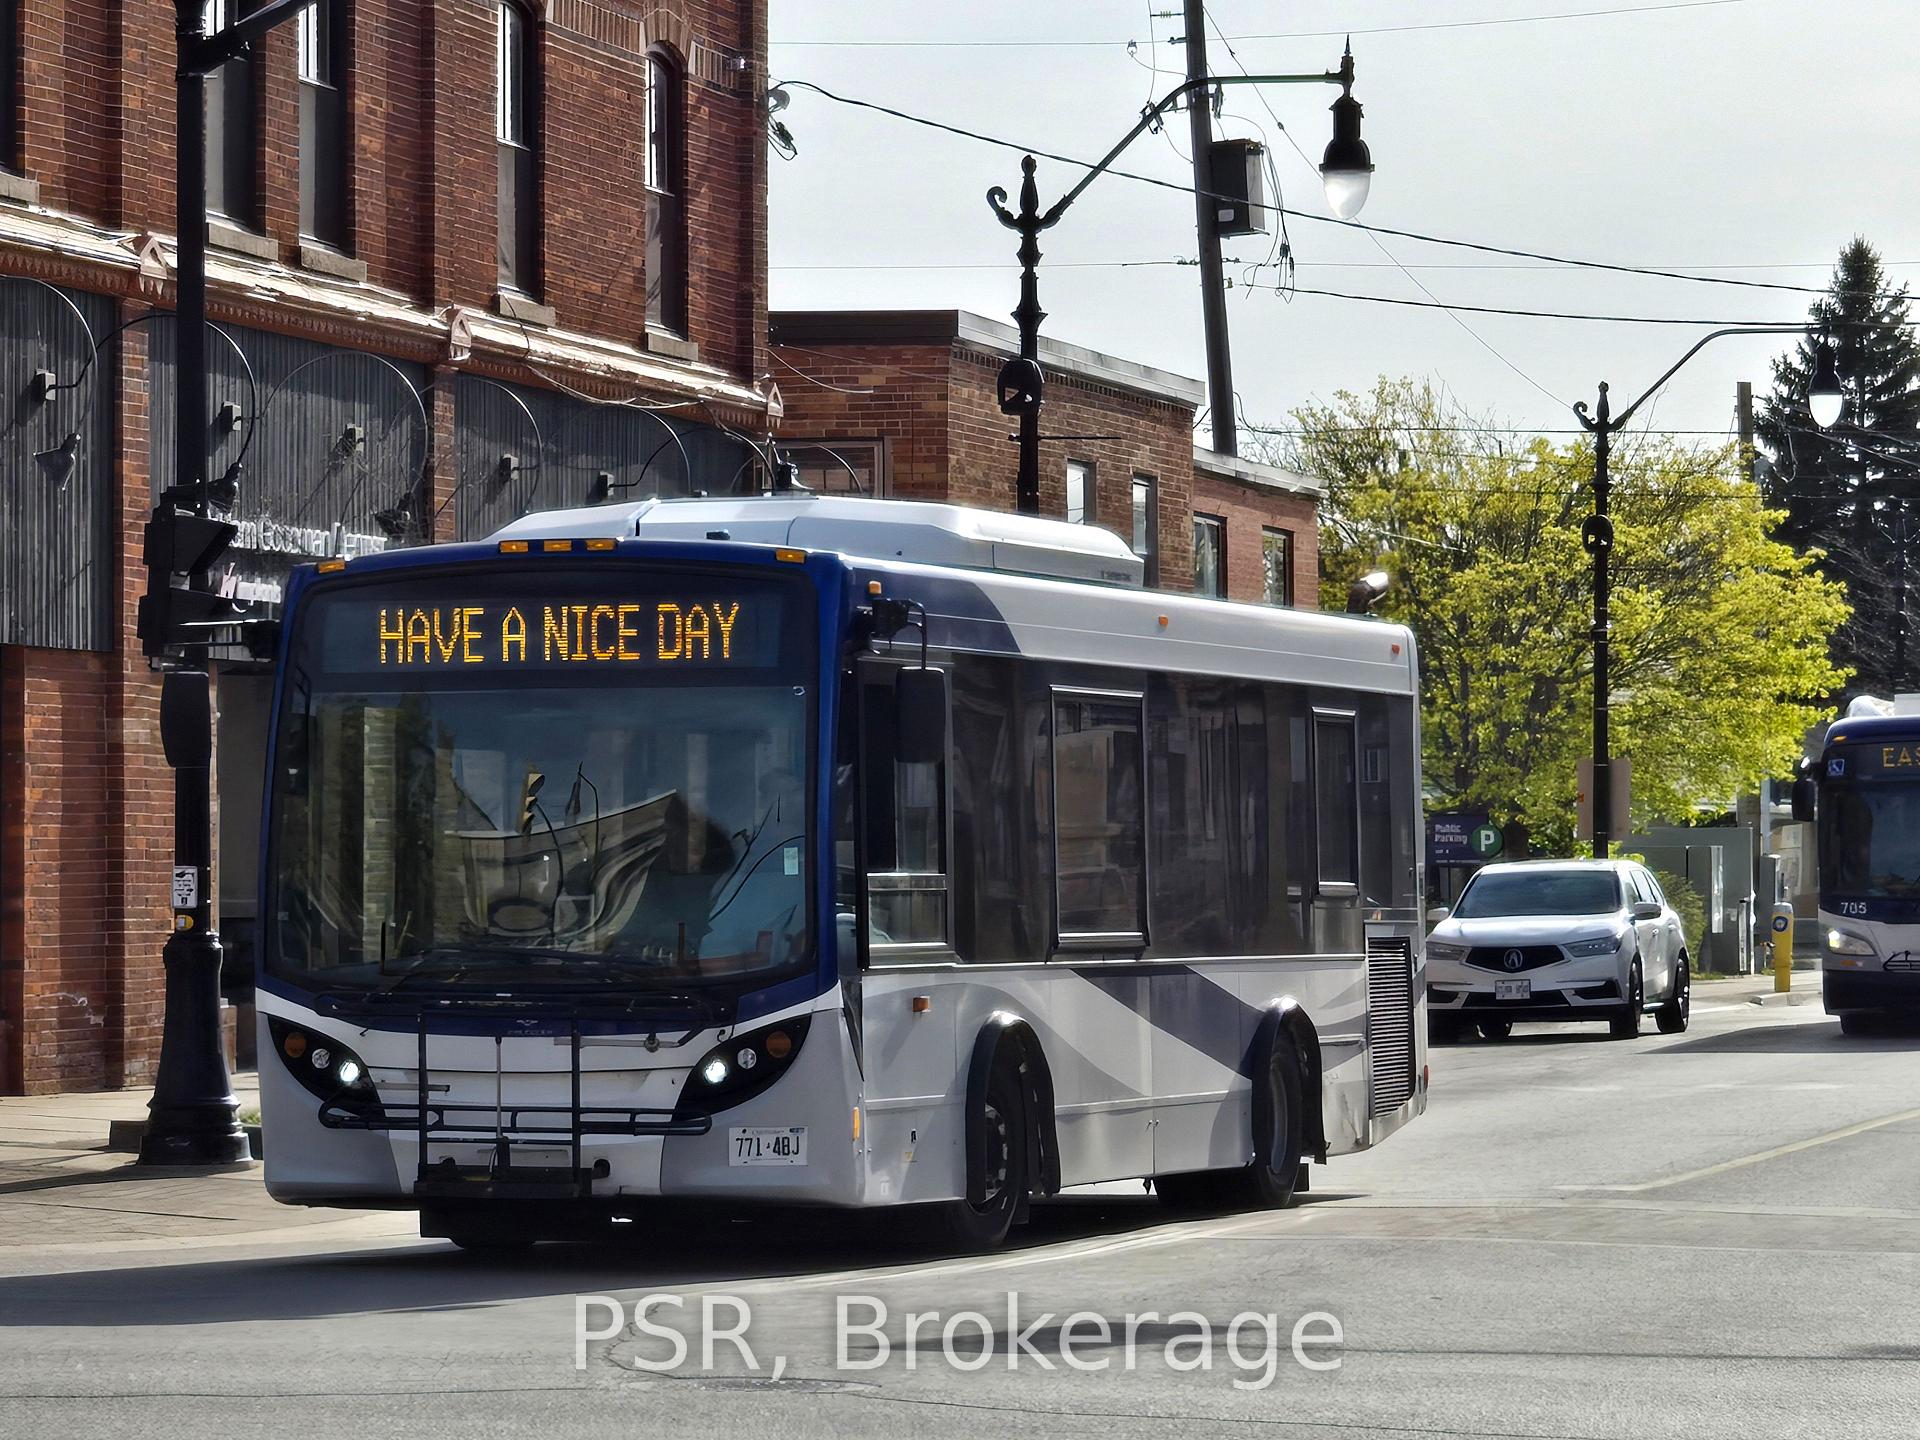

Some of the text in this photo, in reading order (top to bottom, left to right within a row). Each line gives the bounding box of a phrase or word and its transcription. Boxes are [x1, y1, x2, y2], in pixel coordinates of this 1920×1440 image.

[379, 602, 740, 664] HAVE A NICE DAY
[1480, 829, 1495, 852] P
